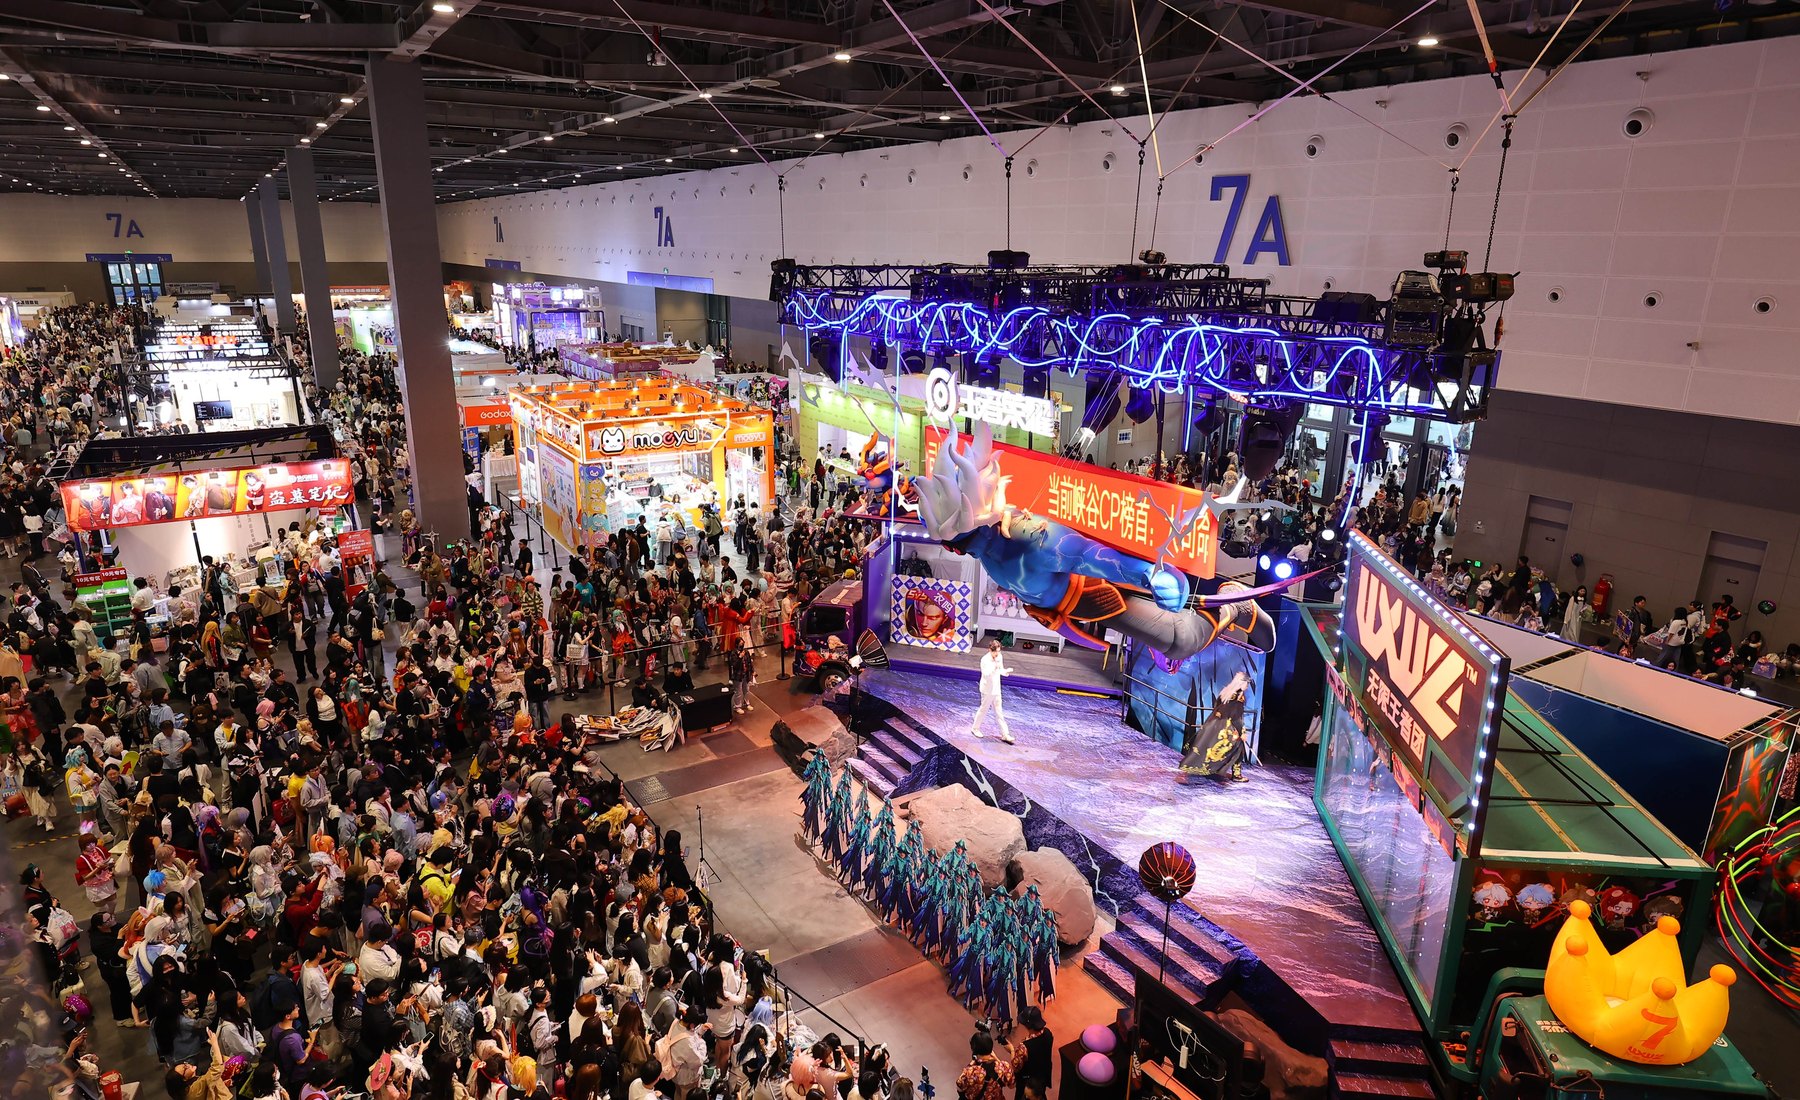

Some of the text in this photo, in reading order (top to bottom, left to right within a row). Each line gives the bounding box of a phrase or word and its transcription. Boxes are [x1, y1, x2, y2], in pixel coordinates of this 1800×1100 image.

[106, 213, 145, 238] 7A
[493, 216, 504, 243] 7A
[654, 206, 675, 248] 7A
[1209, 174, 1291, 266] 7A
[633, 429, 699, 449] moeyu
[1366, 668, 1427, 763] 无限王者团
[1641, 1008, 1678, 1050] 7
